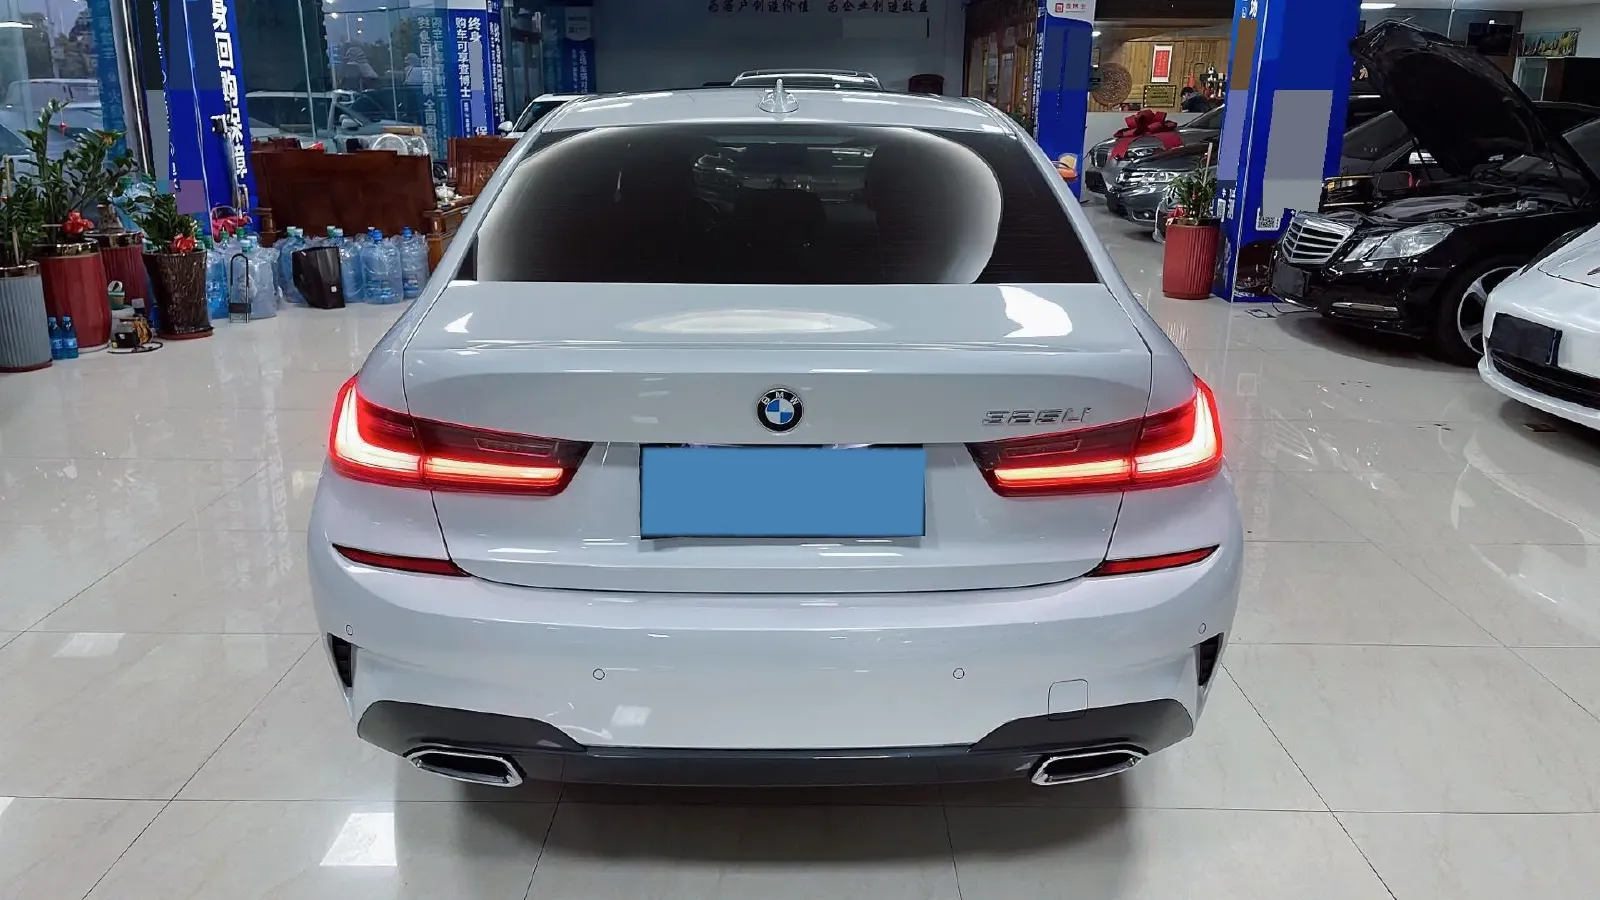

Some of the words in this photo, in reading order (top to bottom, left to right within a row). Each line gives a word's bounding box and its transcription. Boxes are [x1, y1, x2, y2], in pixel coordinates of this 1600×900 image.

[467, 17, 482, 42] 终身
[455, 17, 472, 98] 购车可享查博士
[761, 391, 800, 406] BMW
